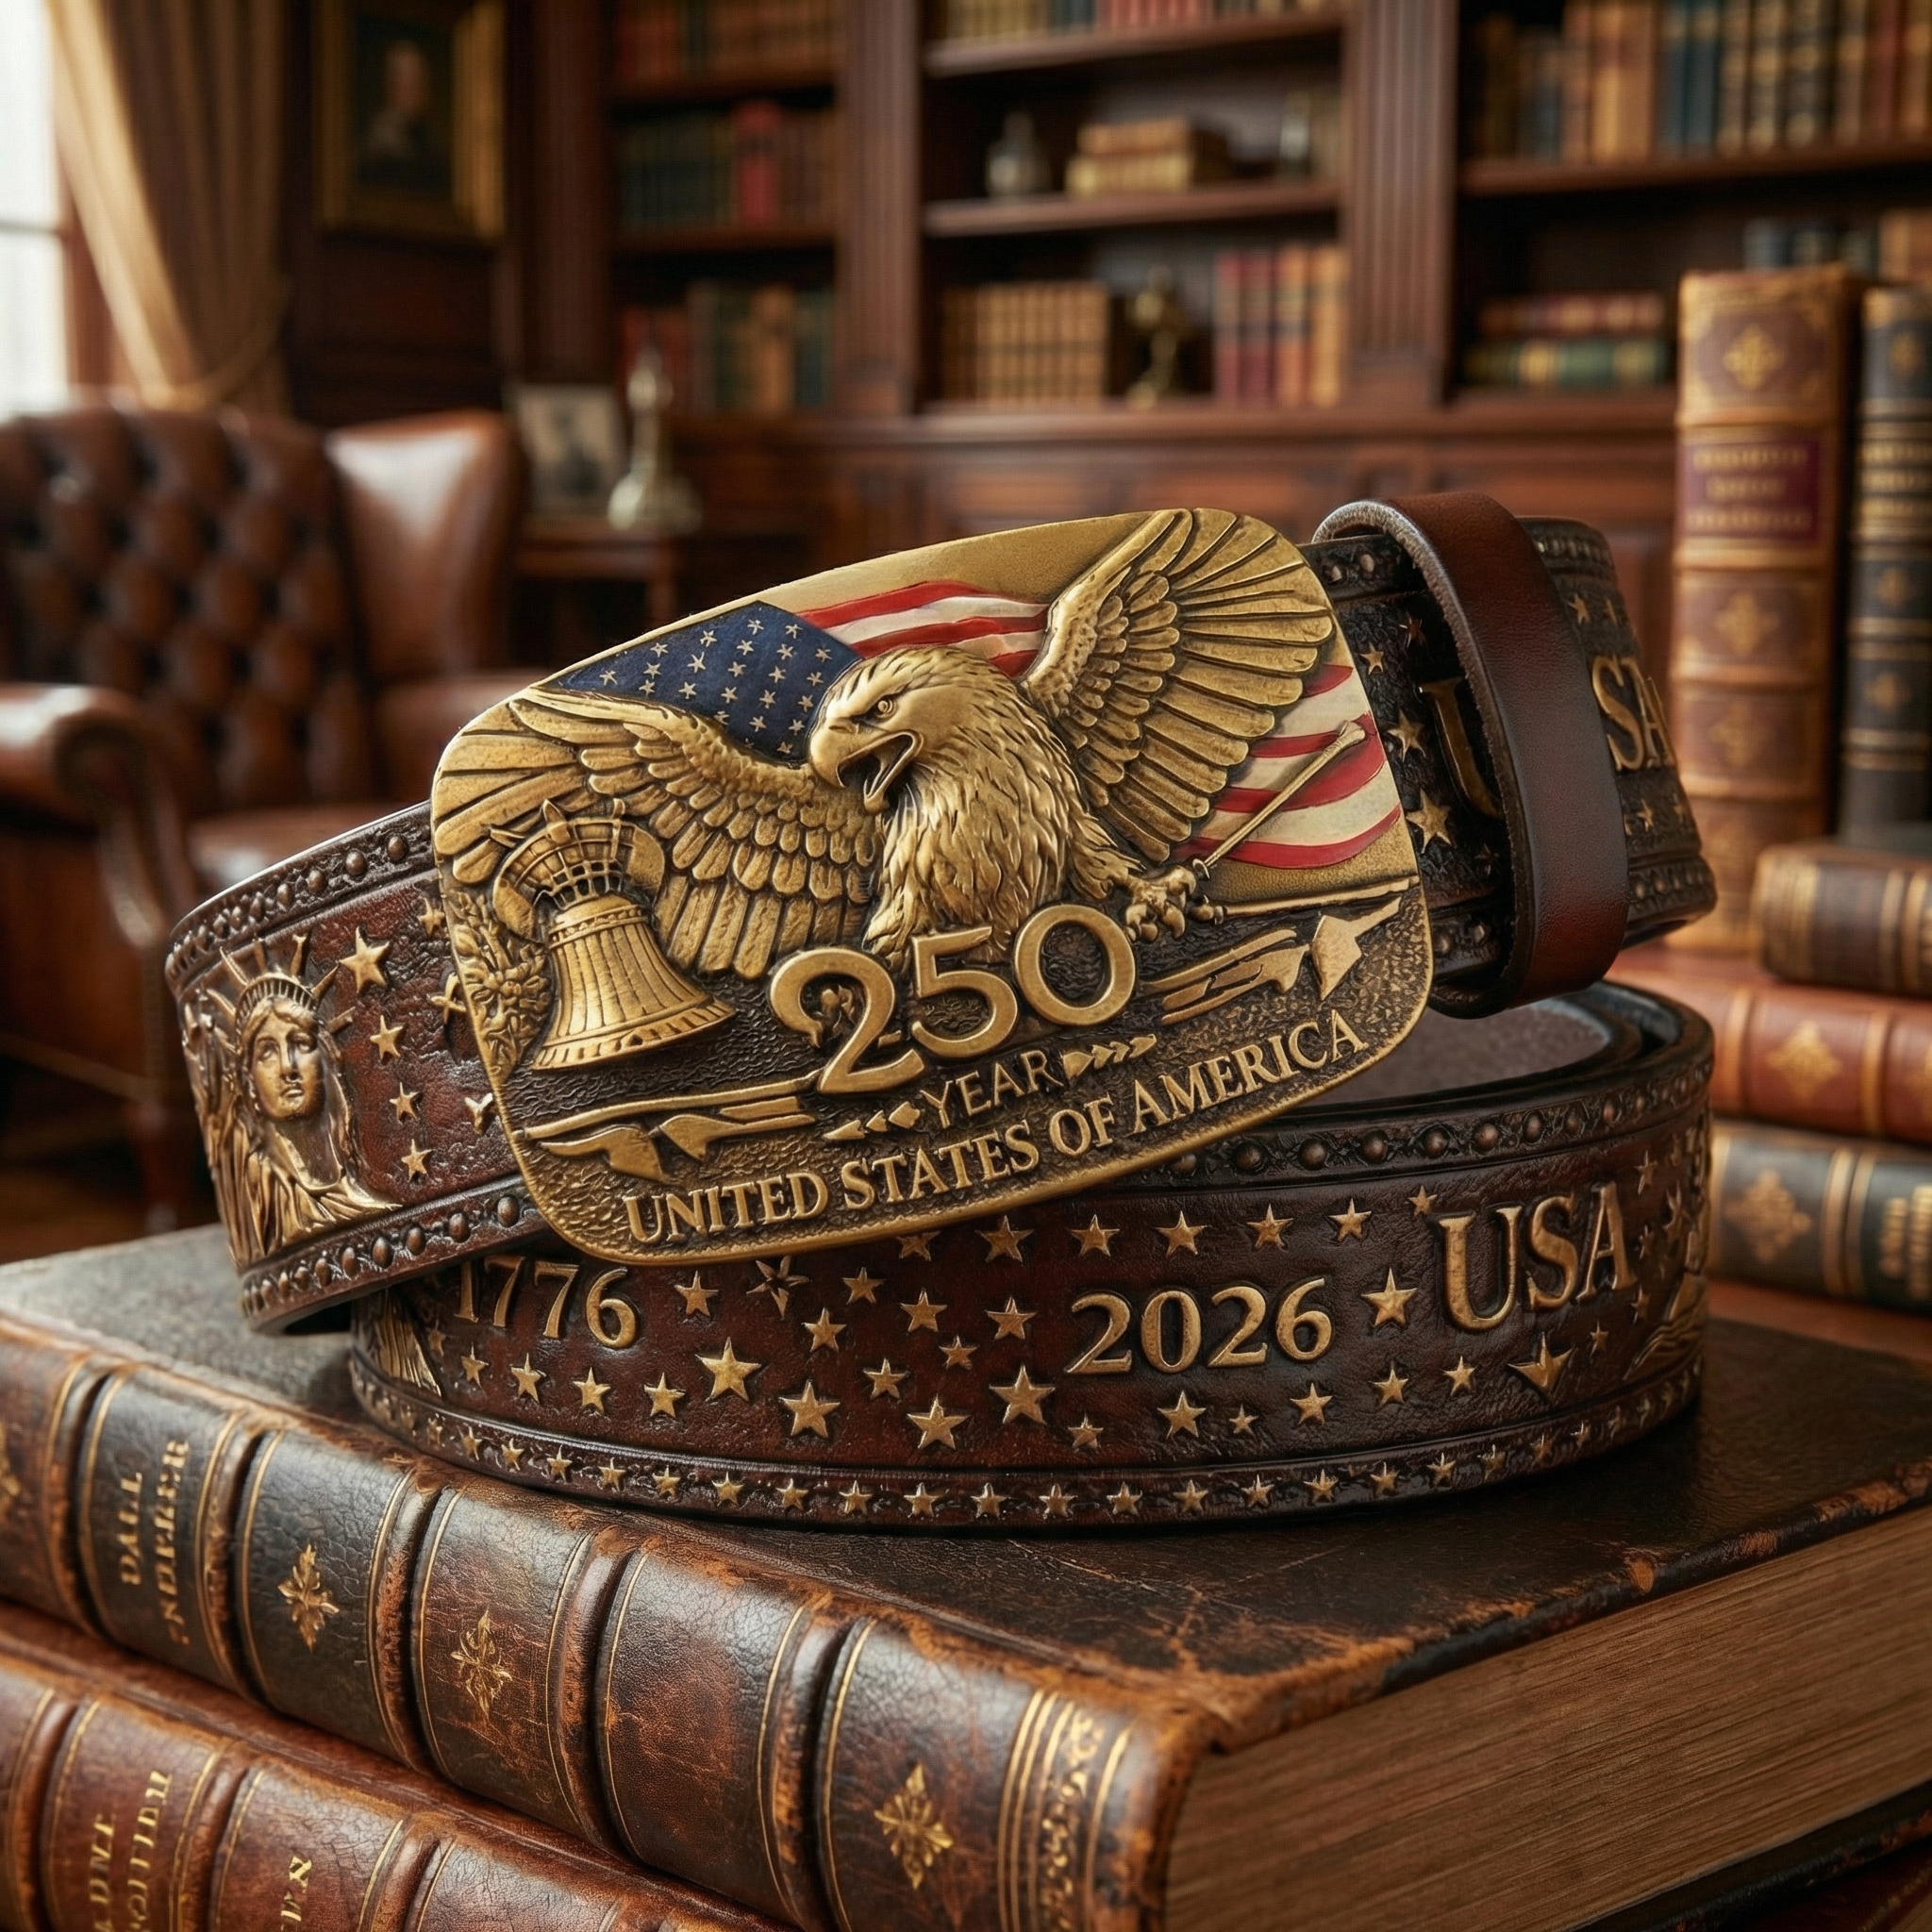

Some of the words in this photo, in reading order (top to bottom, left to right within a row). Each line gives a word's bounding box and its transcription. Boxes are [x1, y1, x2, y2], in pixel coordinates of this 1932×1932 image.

[770, 905, 1136, 1094] 250
[622, 1171, 828, 1244] UNITED
[841, 1119, 1040, 1210] STATES
[1048, 1092, 1116, 1157] OF
[1133, 1009, 1370, 1134] AMERICA
[920, 1050, 1064, 1129] YEAR
[454, 1255, 636, 1349] 1776
[1438, 1180, 1638, 1332] USA
[1064, 1277, 1333, 1375] 2026
